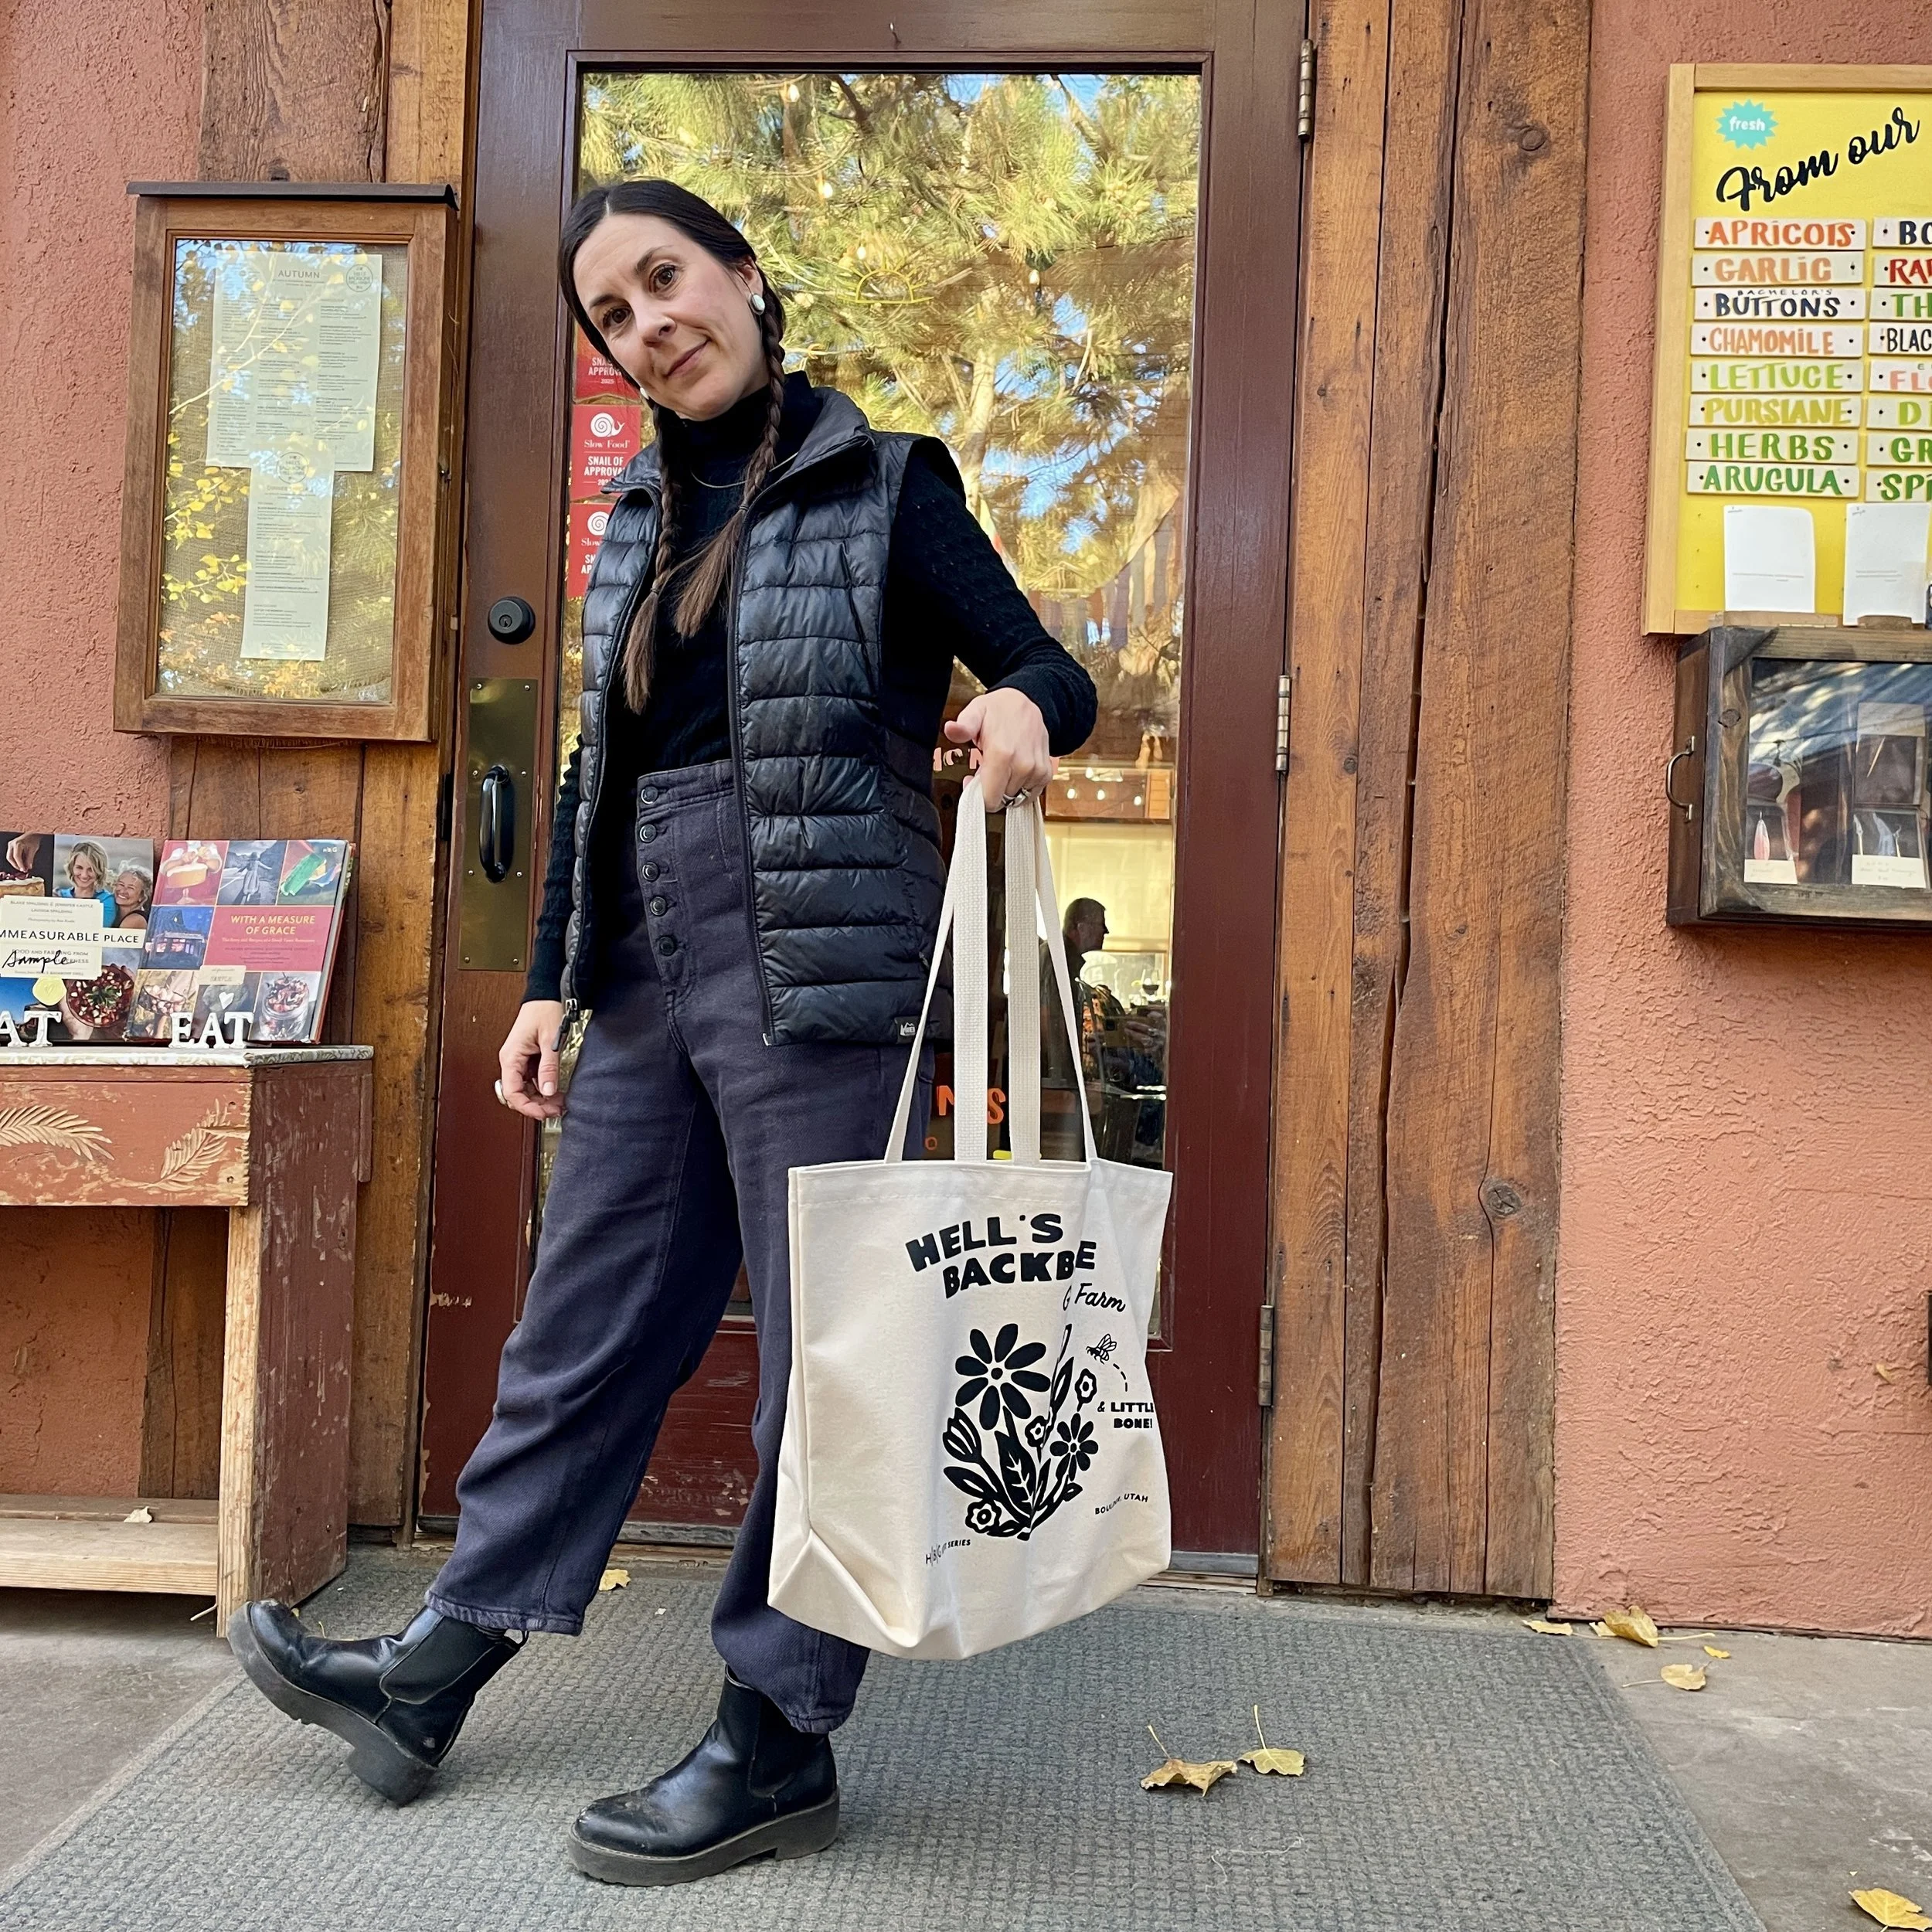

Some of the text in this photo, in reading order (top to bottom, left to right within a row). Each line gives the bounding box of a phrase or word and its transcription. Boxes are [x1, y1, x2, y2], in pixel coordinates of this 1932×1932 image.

[1729, 117, 1766, 132] fresh
[1716, 107, 1920, 212] From our
[278, 270, 321, 278] AUTUMN
[1715, 257, 1832, 284] GARLIC
[1715, 293, 1841, 318] BUTTONS
[1709, 327, 1835, 355] CHAMOMILE
[1709, 362, 1844, 390] LETTUCE
[1710, 434, 1835, 461] HERBS
[584, 467, 625, 476] APPROVA
[588, 456, 624, 466] SNAIL OF
[1702, 464, 1843, 495] ARUGULA
[268, 916, 315, 924] MEASURE
[2, 950, 75, 973] Sample
[168, 1012, 253, 1049] EAT
[906, 1213, 1063, 1272] HELL'S
[943, 1240, 1097, 1299] BACKBE
[1074, 1283, 1126, 1312] Farm
[1097, 1401, 1105, 1412] &
[1124, 1493, 1148, 1502] UTAH
[947, 1539, 971, 1548] SERIES
